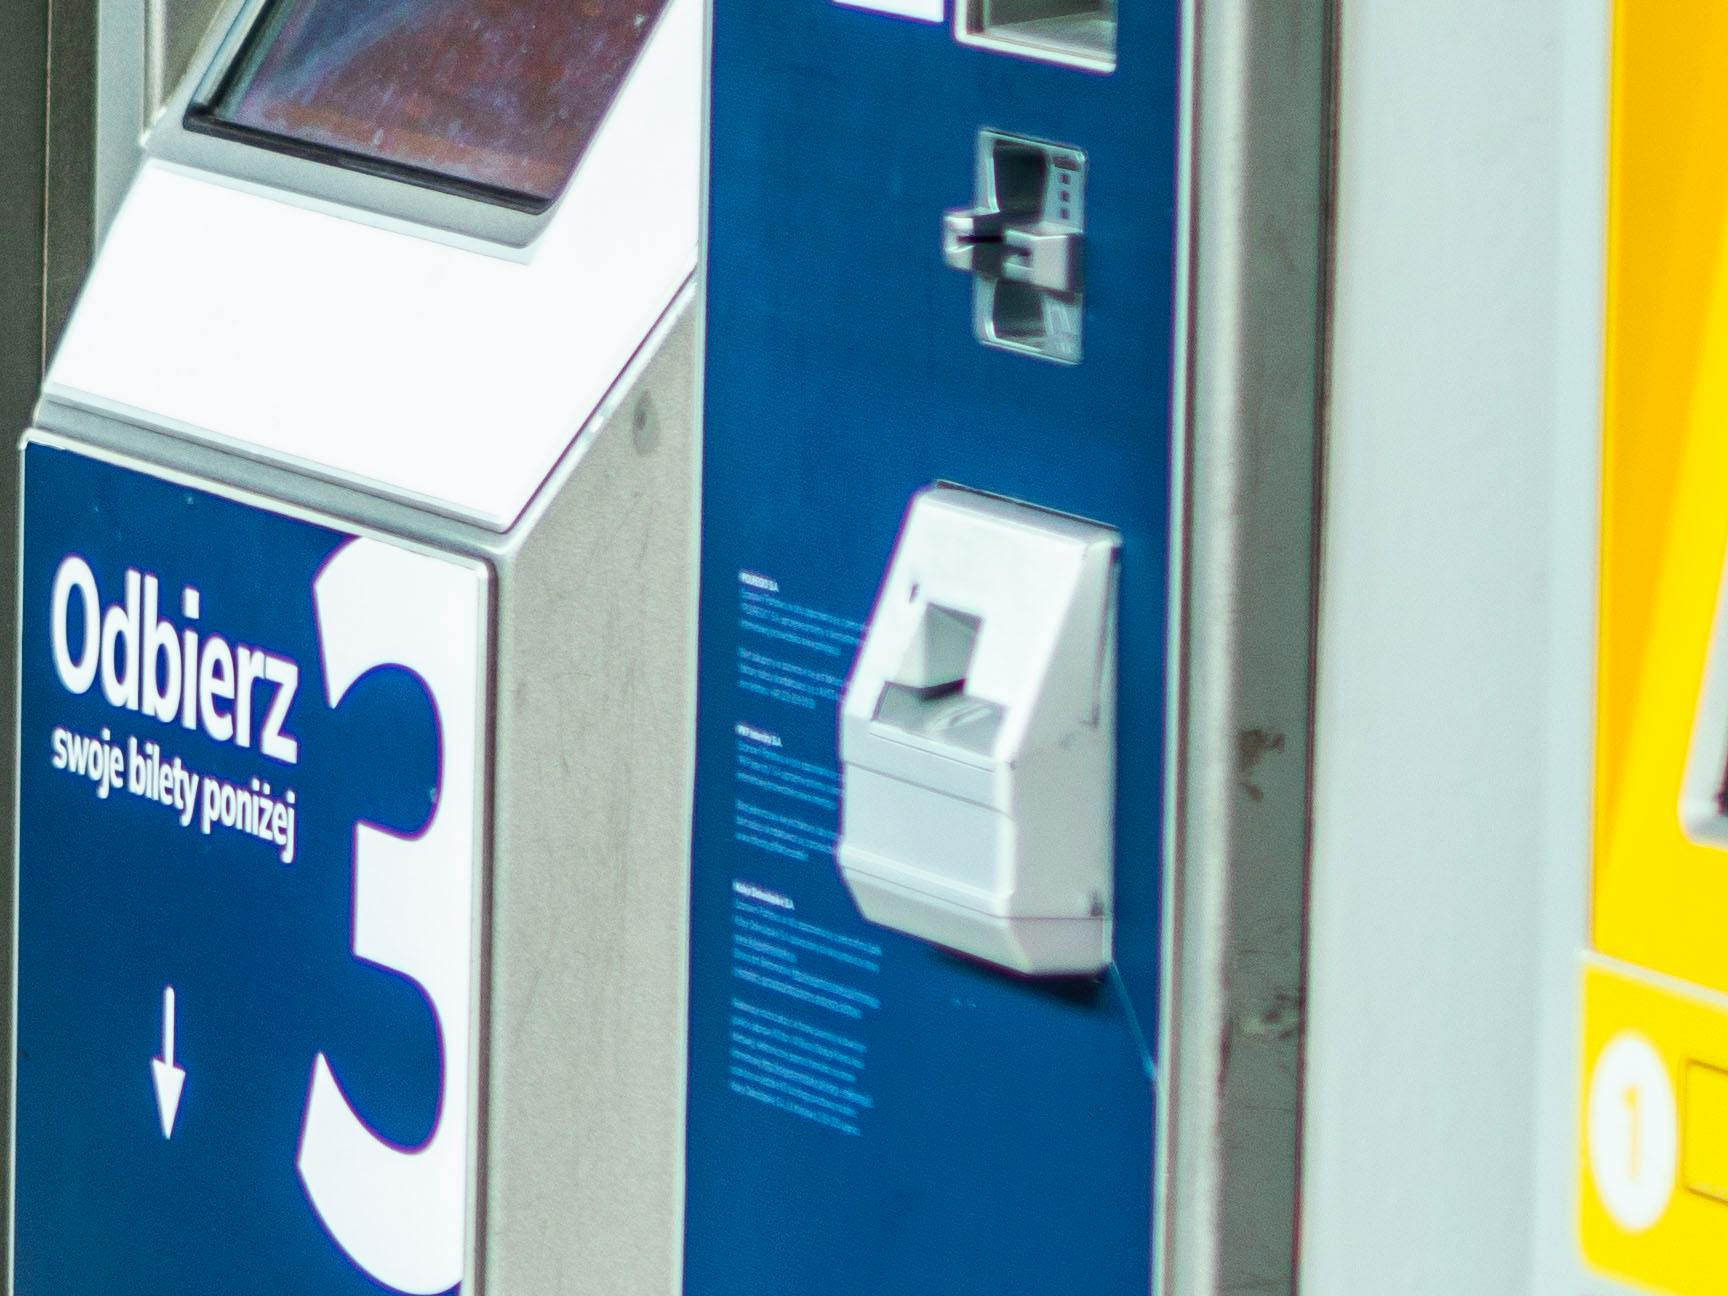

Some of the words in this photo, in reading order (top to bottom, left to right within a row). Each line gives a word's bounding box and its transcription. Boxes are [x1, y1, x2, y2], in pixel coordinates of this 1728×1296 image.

[50, 555, 299, 765] Odbierz
[51, 720, 125, 799] swoje
[126, 734, 200, 828] bilety
[201, 776, 296, 865] poniżej
[296, 534, 472, 1296] 3
[1622, 1083, 1643, 1183] 1
